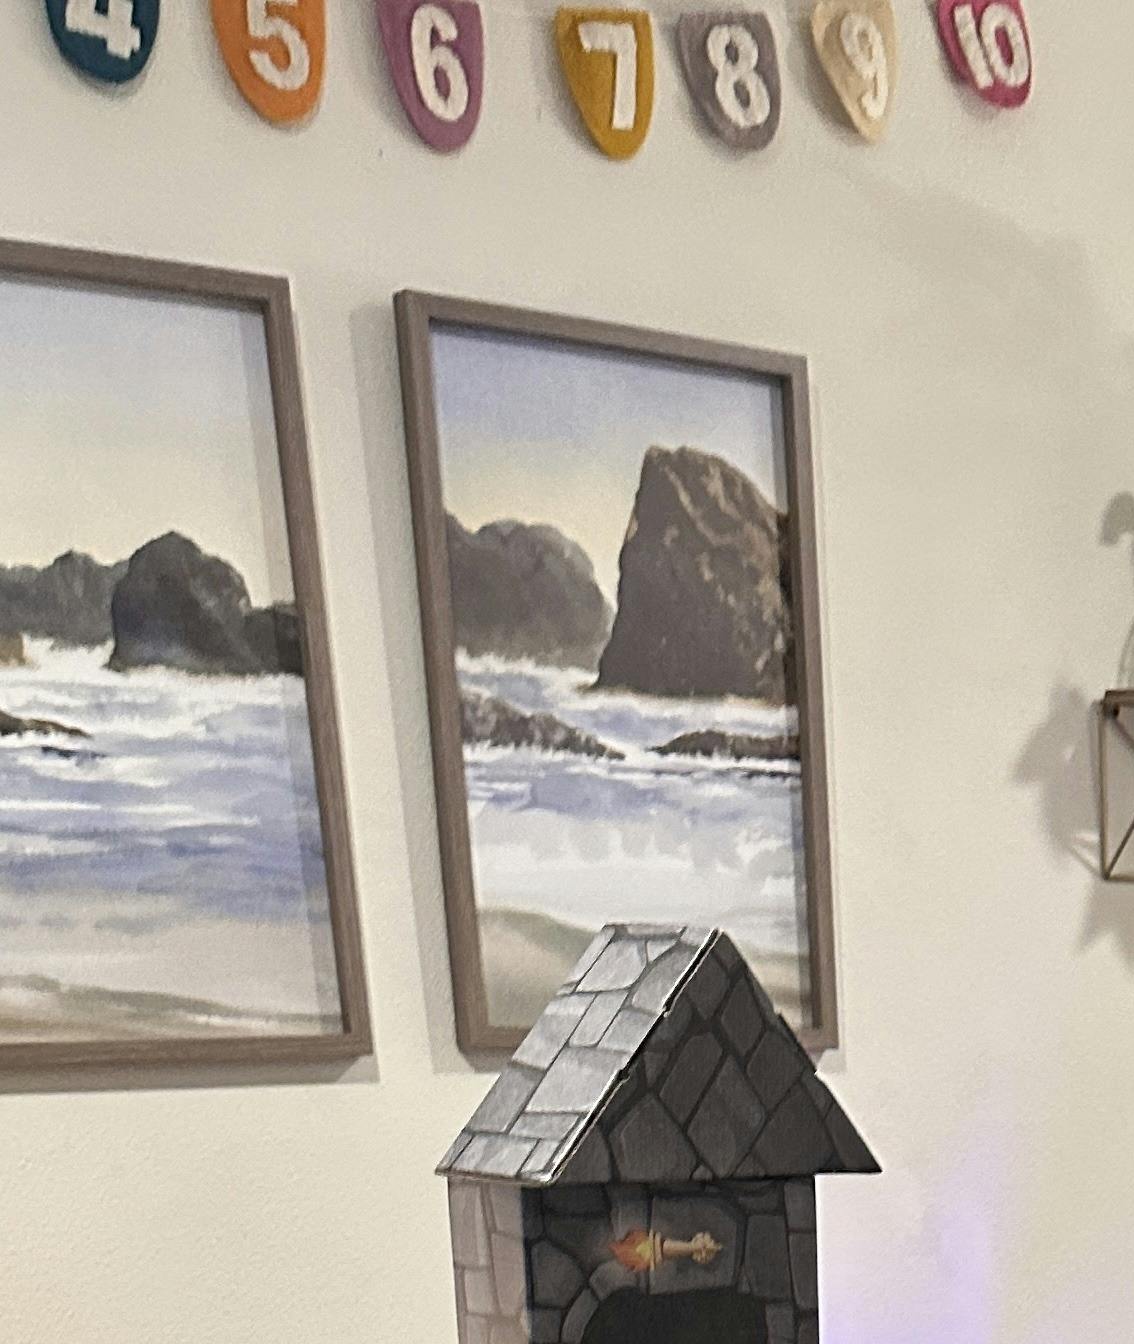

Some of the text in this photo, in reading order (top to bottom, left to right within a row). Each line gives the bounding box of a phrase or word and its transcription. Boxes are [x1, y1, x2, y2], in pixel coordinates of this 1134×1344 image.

[247, 0, 310, 91] 5
[410, 4, 469, 122] 6
[578, 21, 636, 130] 7
[706, 24, 771, 128] 8
[840, 12, 889, 120] 9
[953, 1, 1031, 89] 10
